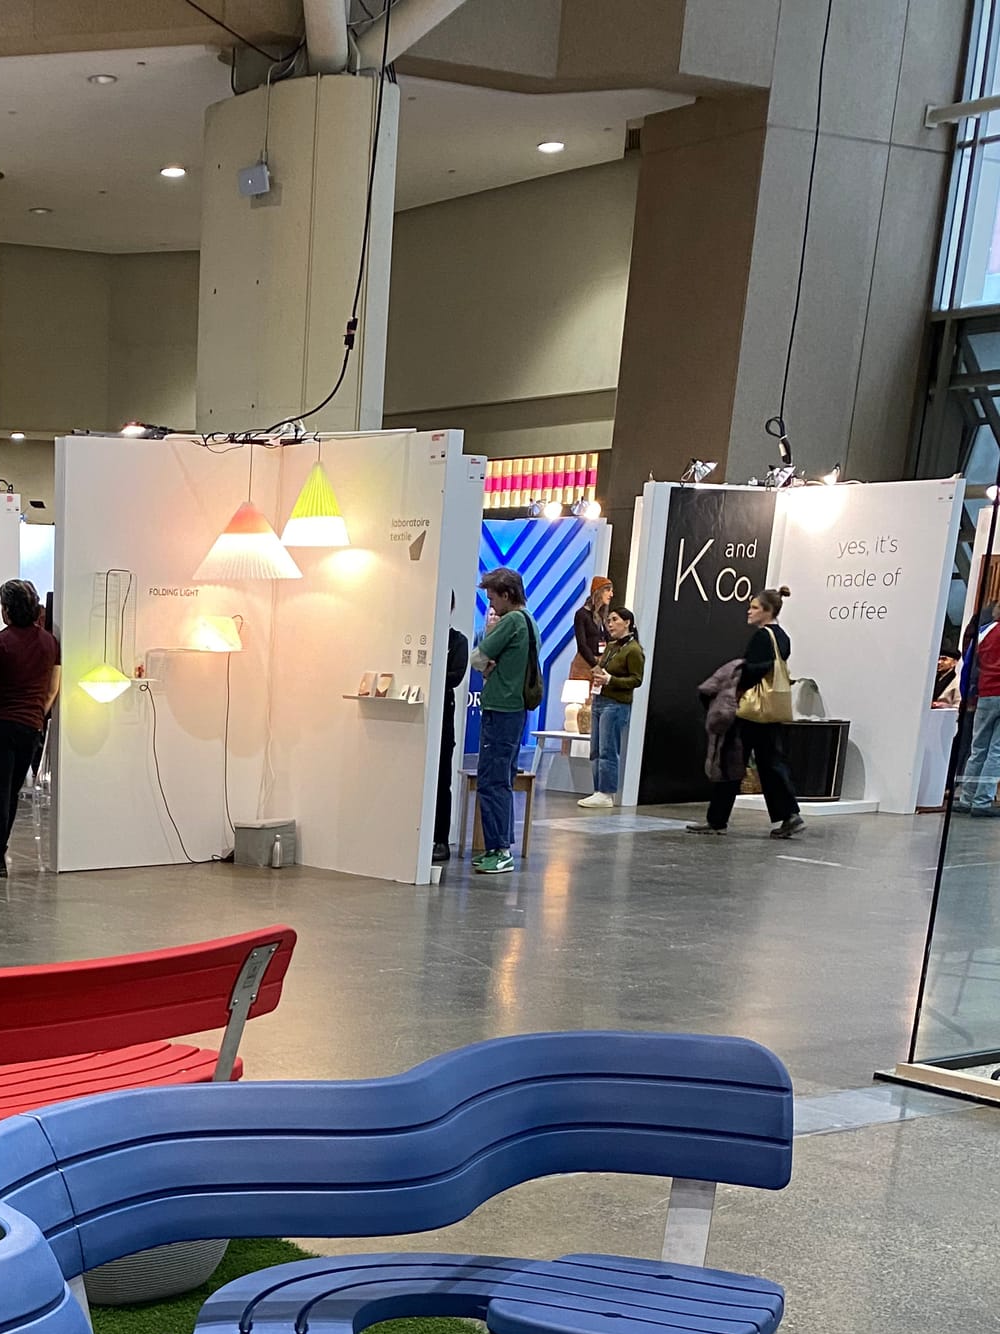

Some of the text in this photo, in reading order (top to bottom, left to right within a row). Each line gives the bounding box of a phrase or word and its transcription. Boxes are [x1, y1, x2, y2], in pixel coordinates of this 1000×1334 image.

[391, 518, 430, 527] laboratoire
[390, 532, 412, 541] textile
[837, 535, 898, 559] yes, it's
[673, 538, 758, 602] K and
[826, 567, 902, 588] made of
[149, 588, 199, 597] FOLDING LIGHT
[829, 600, 888, 620] coffee
